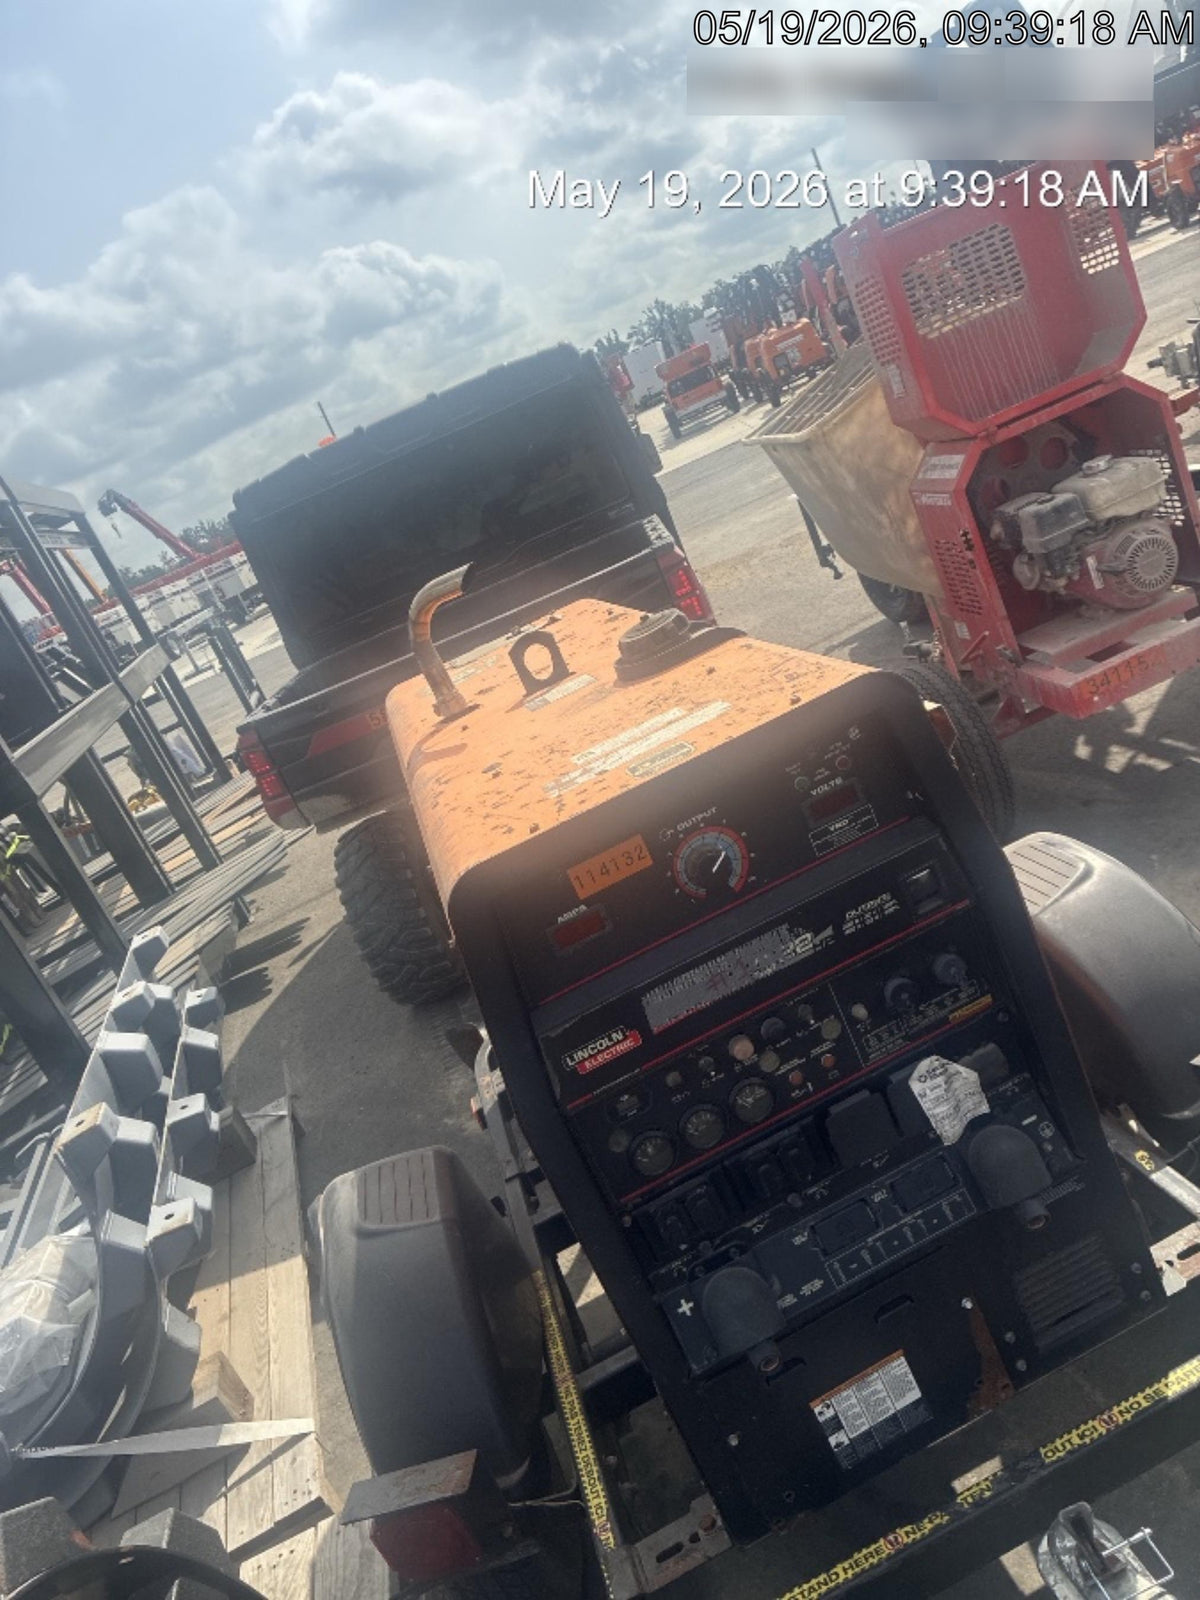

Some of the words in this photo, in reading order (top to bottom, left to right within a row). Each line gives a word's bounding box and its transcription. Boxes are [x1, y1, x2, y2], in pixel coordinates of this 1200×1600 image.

[676, 806, 718, 831] OUTPUT
[573, 844, 648, 890] 114132
[566, 1029, 624, 1066] LINCOLN
[584, 1038, 635, 1069] ELECTRIC
[843, 1544, 887, 1574] HERE
[1118, 1400, 1142, 1418] NO
